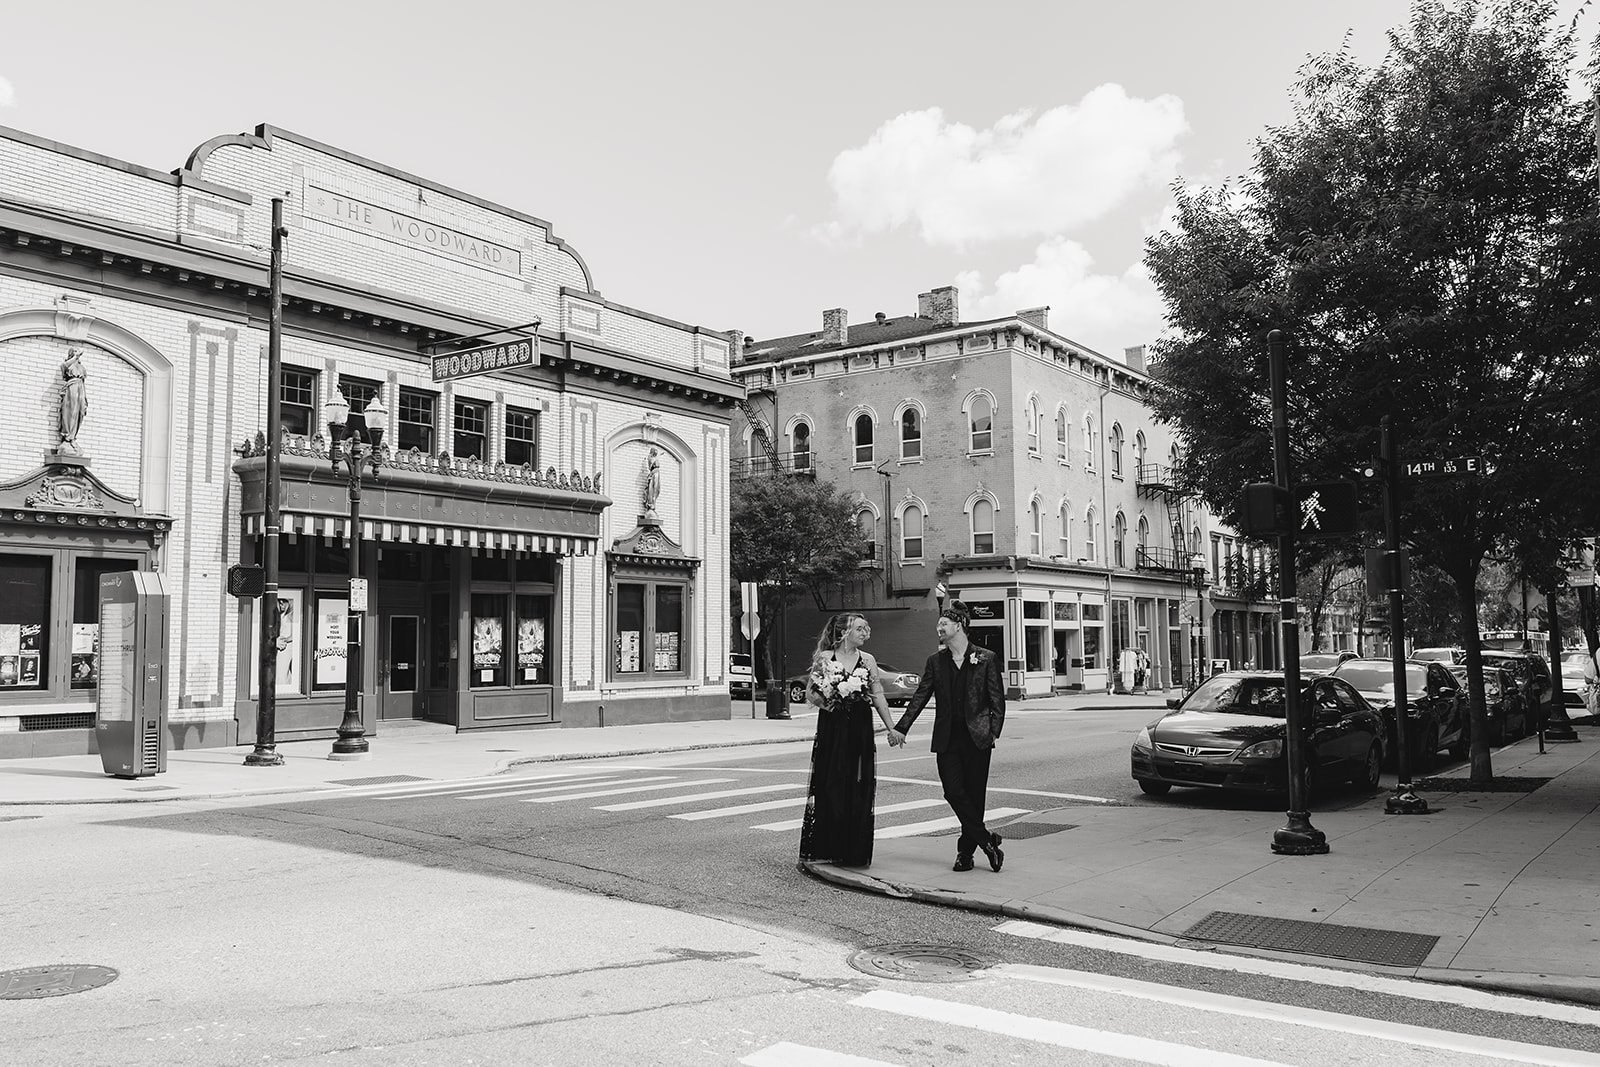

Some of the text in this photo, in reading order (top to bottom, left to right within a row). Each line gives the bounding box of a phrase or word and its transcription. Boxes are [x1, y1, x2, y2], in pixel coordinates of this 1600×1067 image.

[332, 197, 503, 264] THE WOODWARD
[434, 342, 530, 377] WOODWARD
[1407, 462, 1435, 476] 14TH
[1467, 459, 1476, 471] E
[1443, 465, 1457, 473] 133
